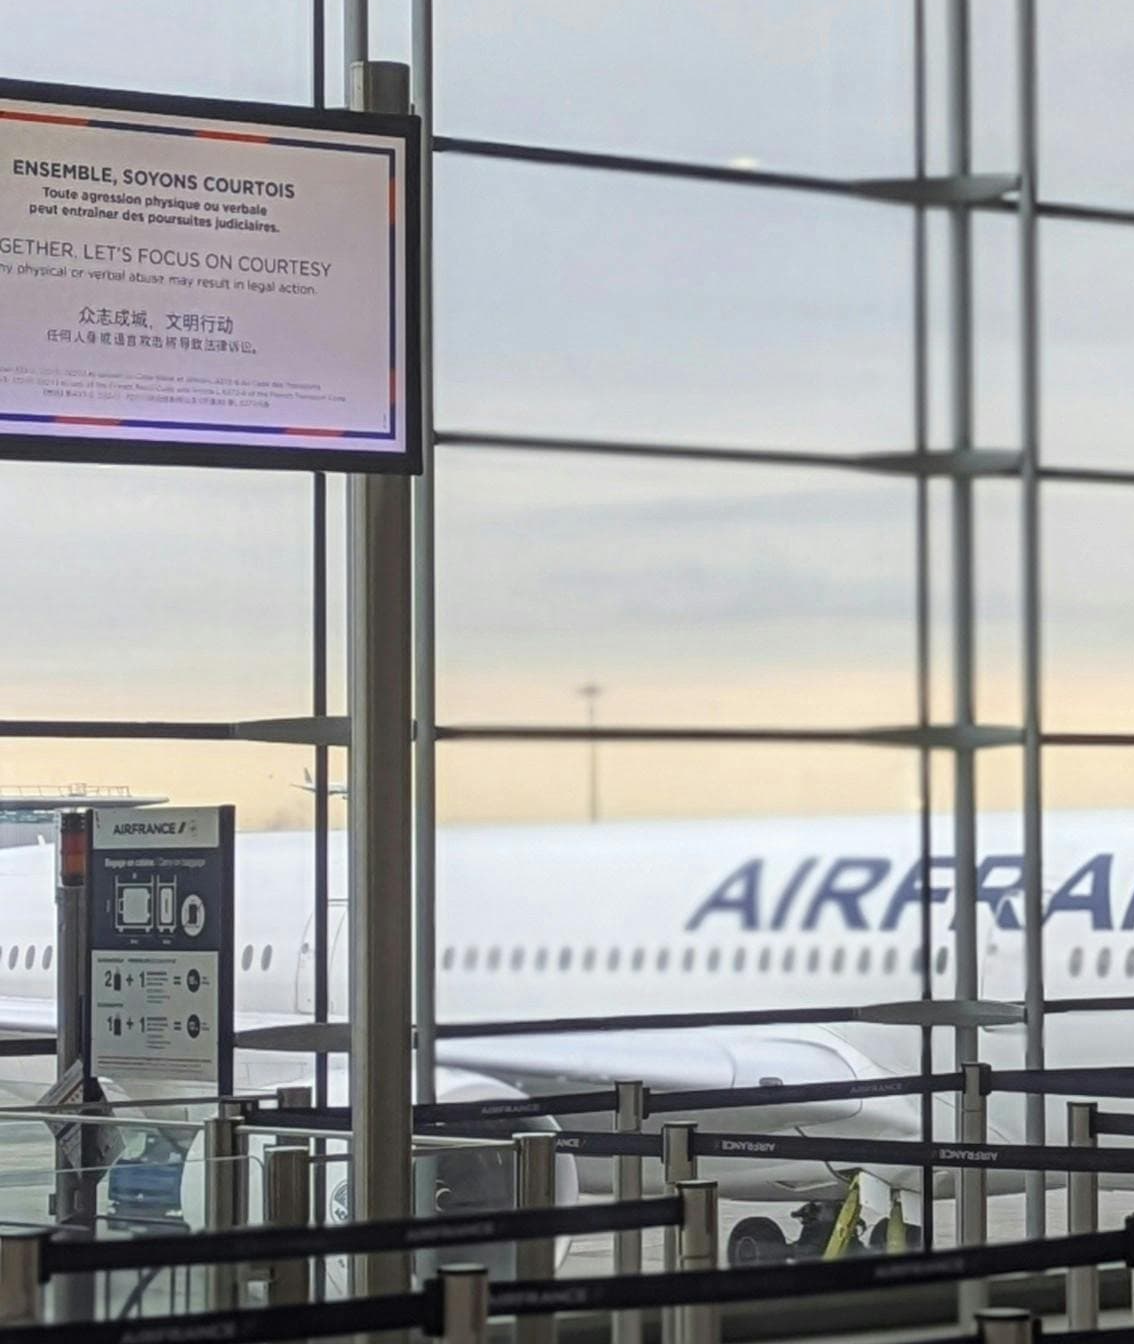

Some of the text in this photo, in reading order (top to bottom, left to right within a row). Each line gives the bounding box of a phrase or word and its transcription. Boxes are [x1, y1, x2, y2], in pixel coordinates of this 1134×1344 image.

[13, 159, 296, 199] ENSEMBLE, SOYONS COURTOIS
[29, 203, 59, 215] peut
[122, 211, 145, 223] des
[148, 213, 212, 228] poursuites
[42, 187, 78, 200] Toute
[145, 196, 200, 212] physique
[204, 202, 219, 212] ou
[222, 202, 268, 216] verbale
[84, 243, 132, 262] LET'S
[138, 248, 200, 268] FOCUS
[205, 253, 232, 270] ON
[238, 256, 332, 277] COURTESY
[17, 263, 67, 278] physical
[71, 268, 84, 278] or
[88, 270, 126, 281] verbal
[168, 275, 194, 287] may
[197, 277, 230, 290] result
[234, 279, 244, 290] in
[247, 280, 276, 294] legal
[278, 283, 318, 296] action.
[113, 822, 176, 835] AIRFRANCE
